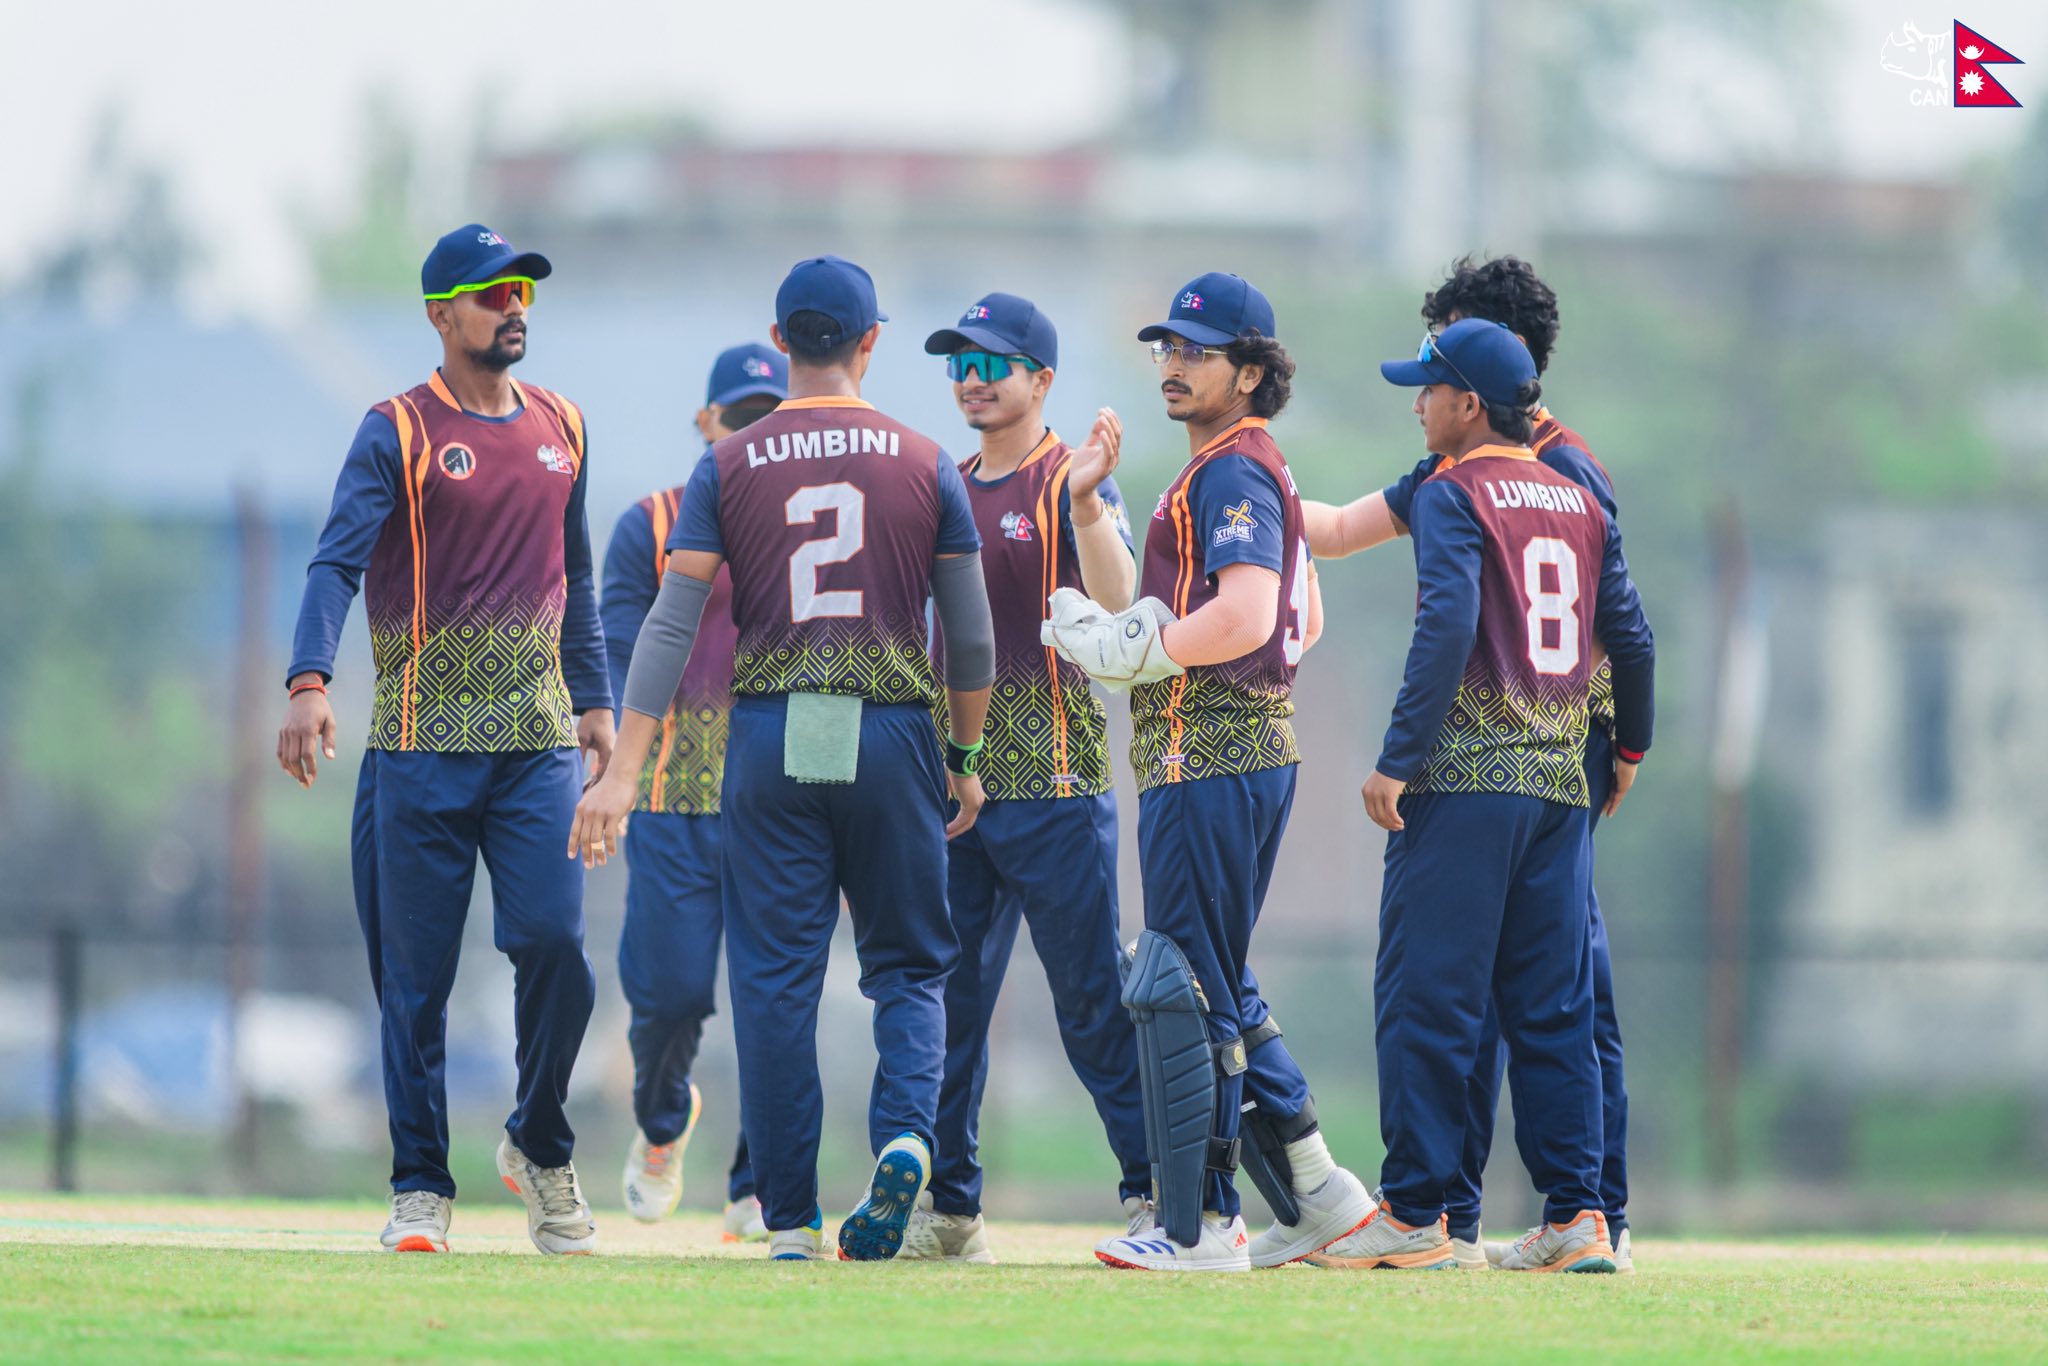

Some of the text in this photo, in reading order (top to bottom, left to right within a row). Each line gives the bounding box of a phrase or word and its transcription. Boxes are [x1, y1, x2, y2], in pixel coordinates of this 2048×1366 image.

[746, 428, 899, 469] LUMBINI
[1485, 480, 1587, 515] LUMBINI
[784, 481, 865, 624] 2
[1215, 525, 1250, 540] XTREME
[1522, 536, 1580, 676] 8
